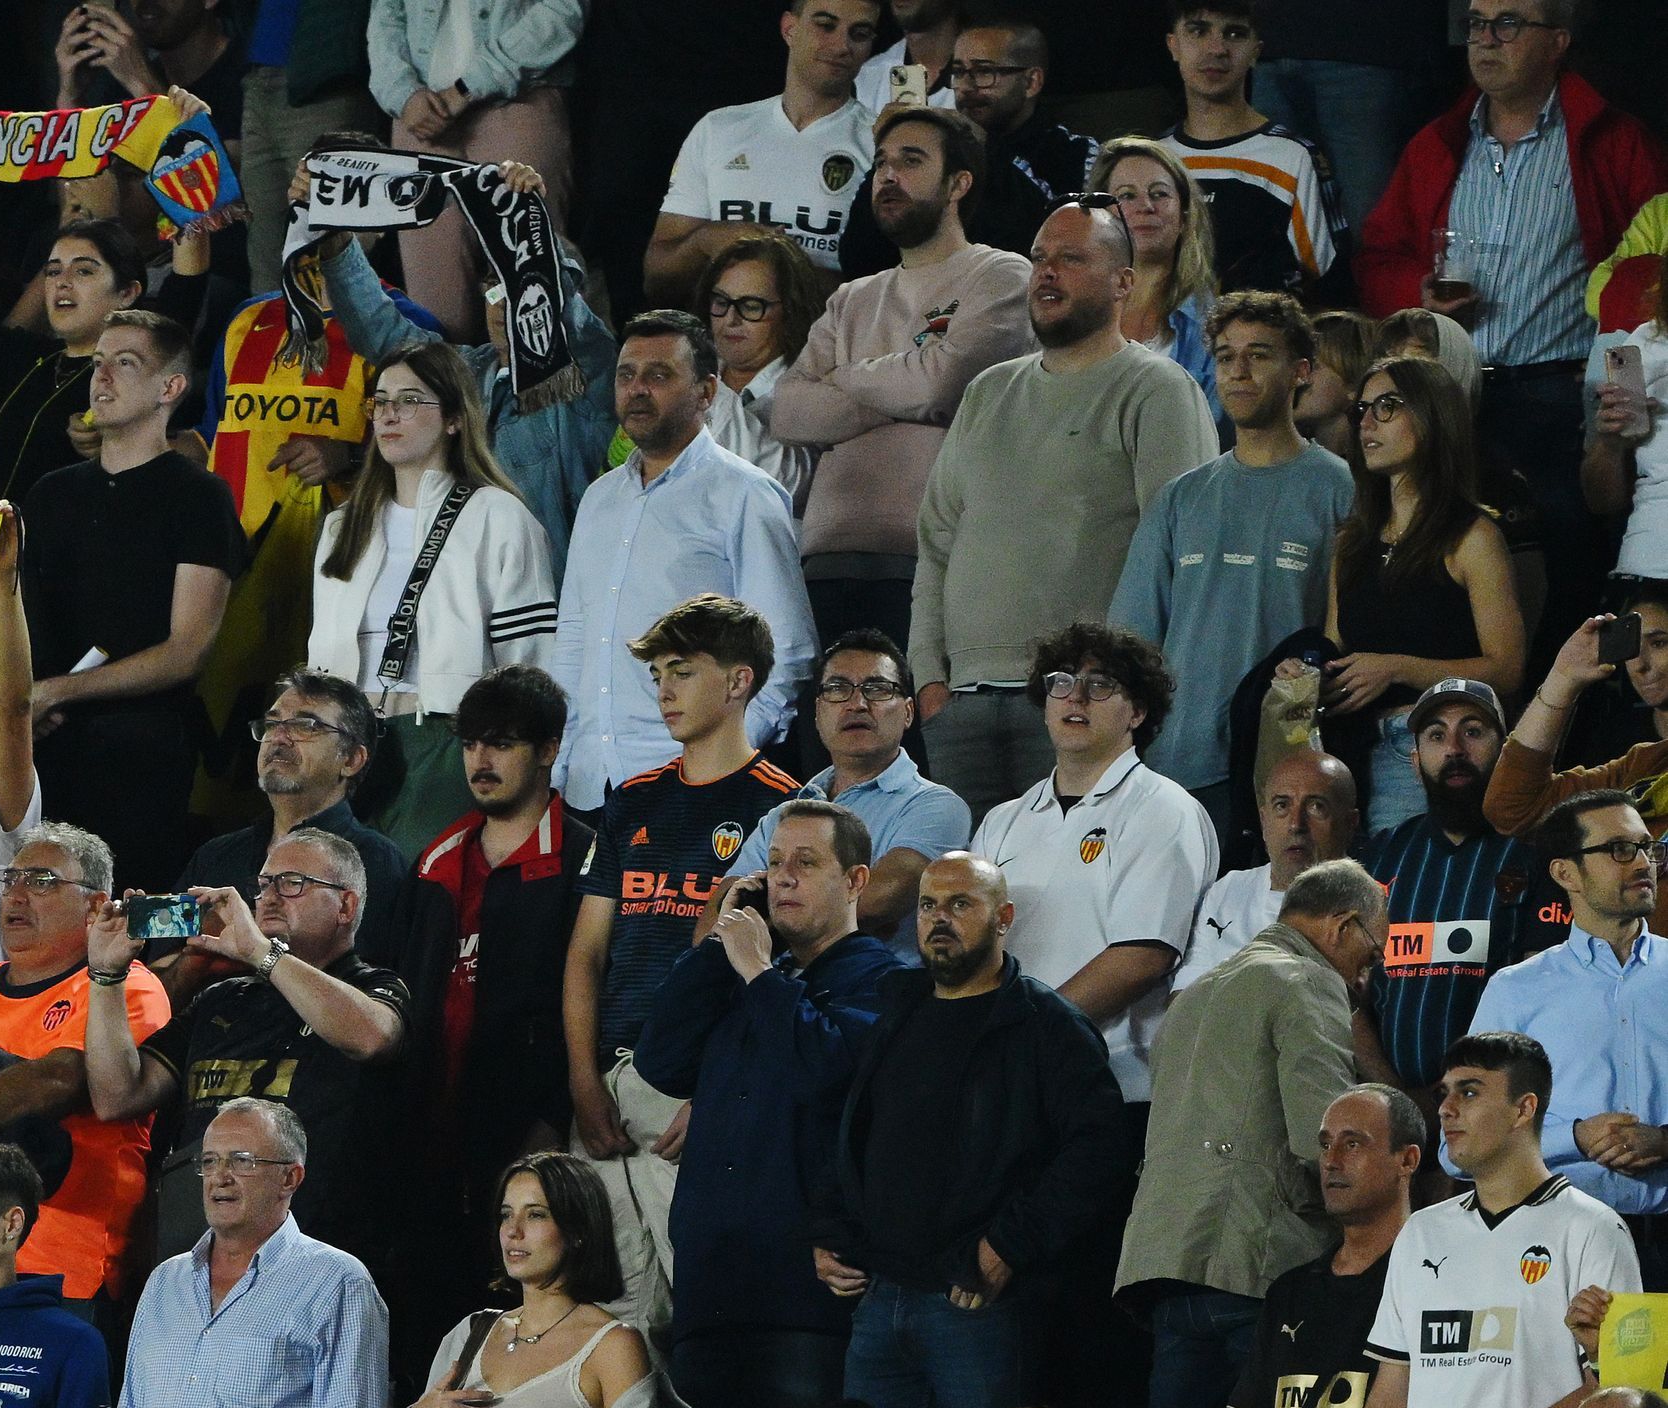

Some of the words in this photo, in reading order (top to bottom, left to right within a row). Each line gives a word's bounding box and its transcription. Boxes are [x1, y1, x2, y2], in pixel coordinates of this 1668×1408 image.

[224, 393, 341, 427] TOYOTA
[621, 870, 722, 901] BLU
[621, 898, 705, 920] smartphone
[1389, 935, 1424, 956] TM
[1396, 967, 1417, 978] Real
[1418, 966, 1450, 977] Estate
[1452, 965, 1486, 978] Group
[1427, 1321, 1461, 1345] TM
[1421, 1358, 1437, 1368] TM
[1438, 1357, 1456, 1367] Real
[1478, 1353, 1513, 1367] Group
